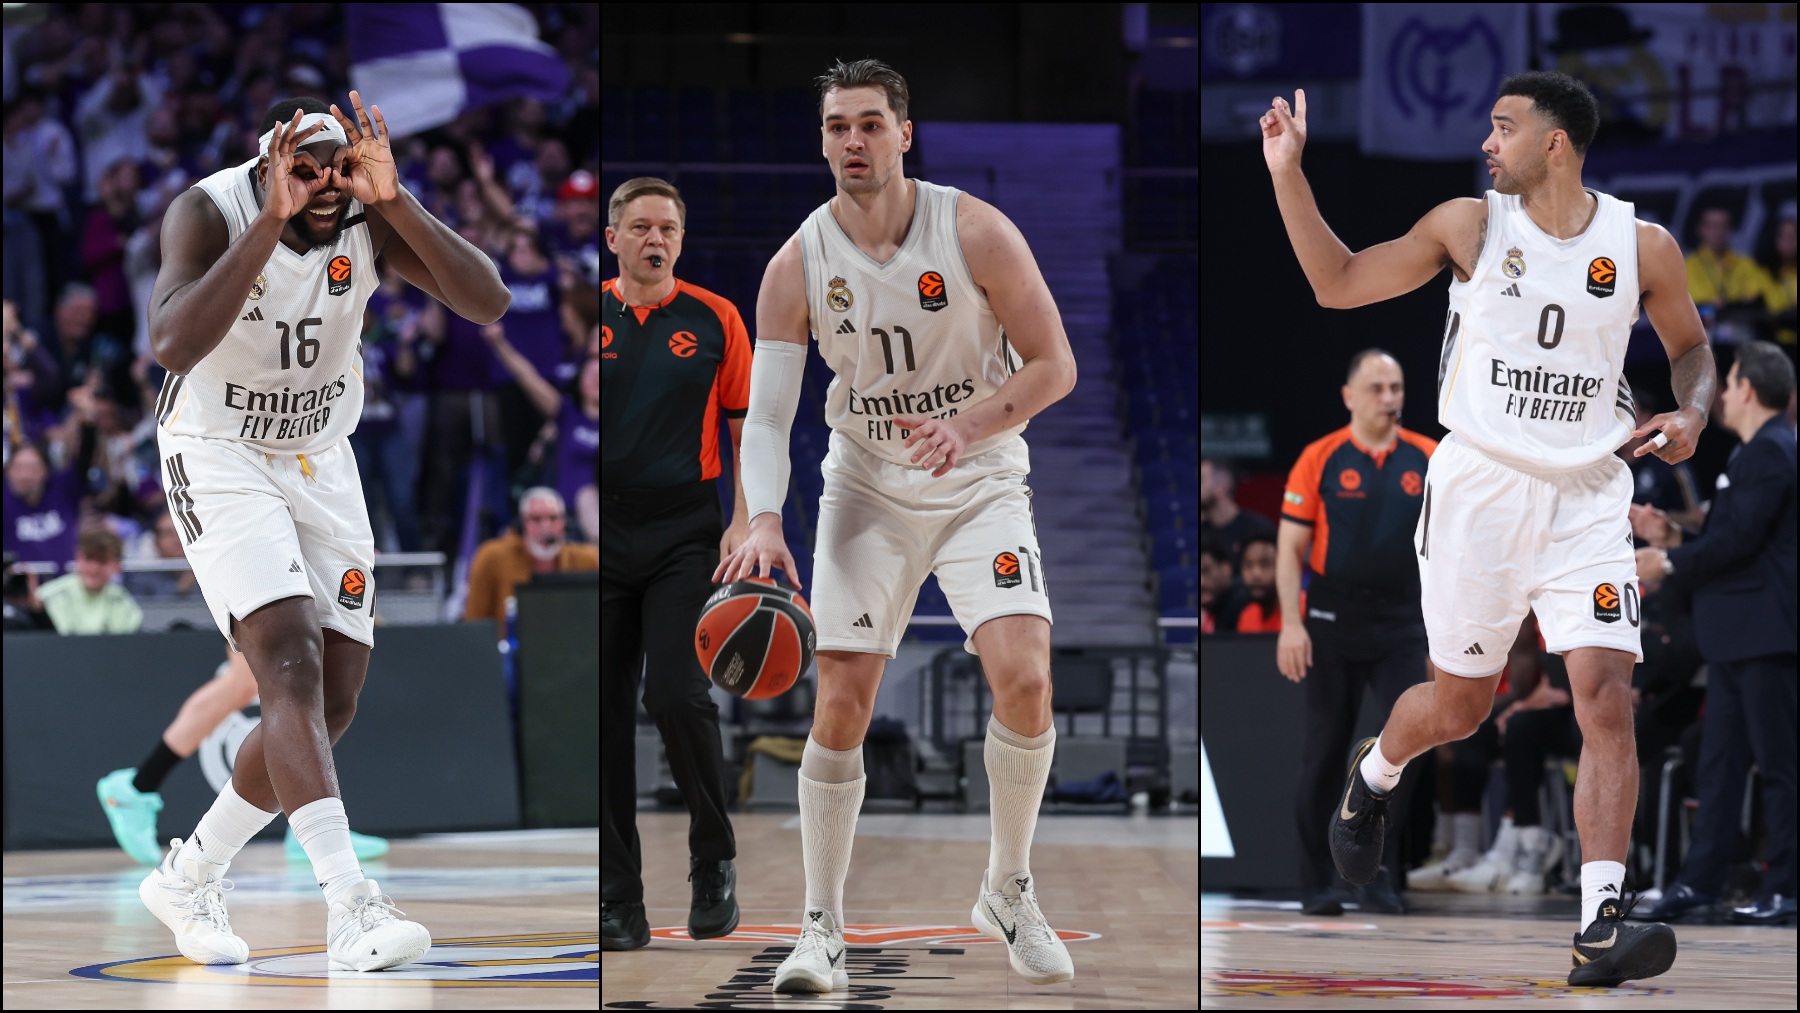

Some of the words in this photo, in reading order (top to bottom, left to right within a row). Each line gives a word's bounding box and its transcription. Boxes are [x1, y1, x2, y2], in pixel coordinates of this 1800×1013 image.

[276, 317, 323, 370] 16
[1537, 303, 1566, 350] 0
[871, 325, 916, 375] 11
[225, 374, 346, 414] Emirates
[849, 378, 975, 417] Emirates
[1491, 358, 1604, 398] Emirates
[239, 414, 273, 440] FLY
[276, 406, 331, 440] BETTER
[1530, 397, 1587, 422] BETTER
[867, 419, 893, 441] FLY
[1623, 582, 1640, 628] 0
